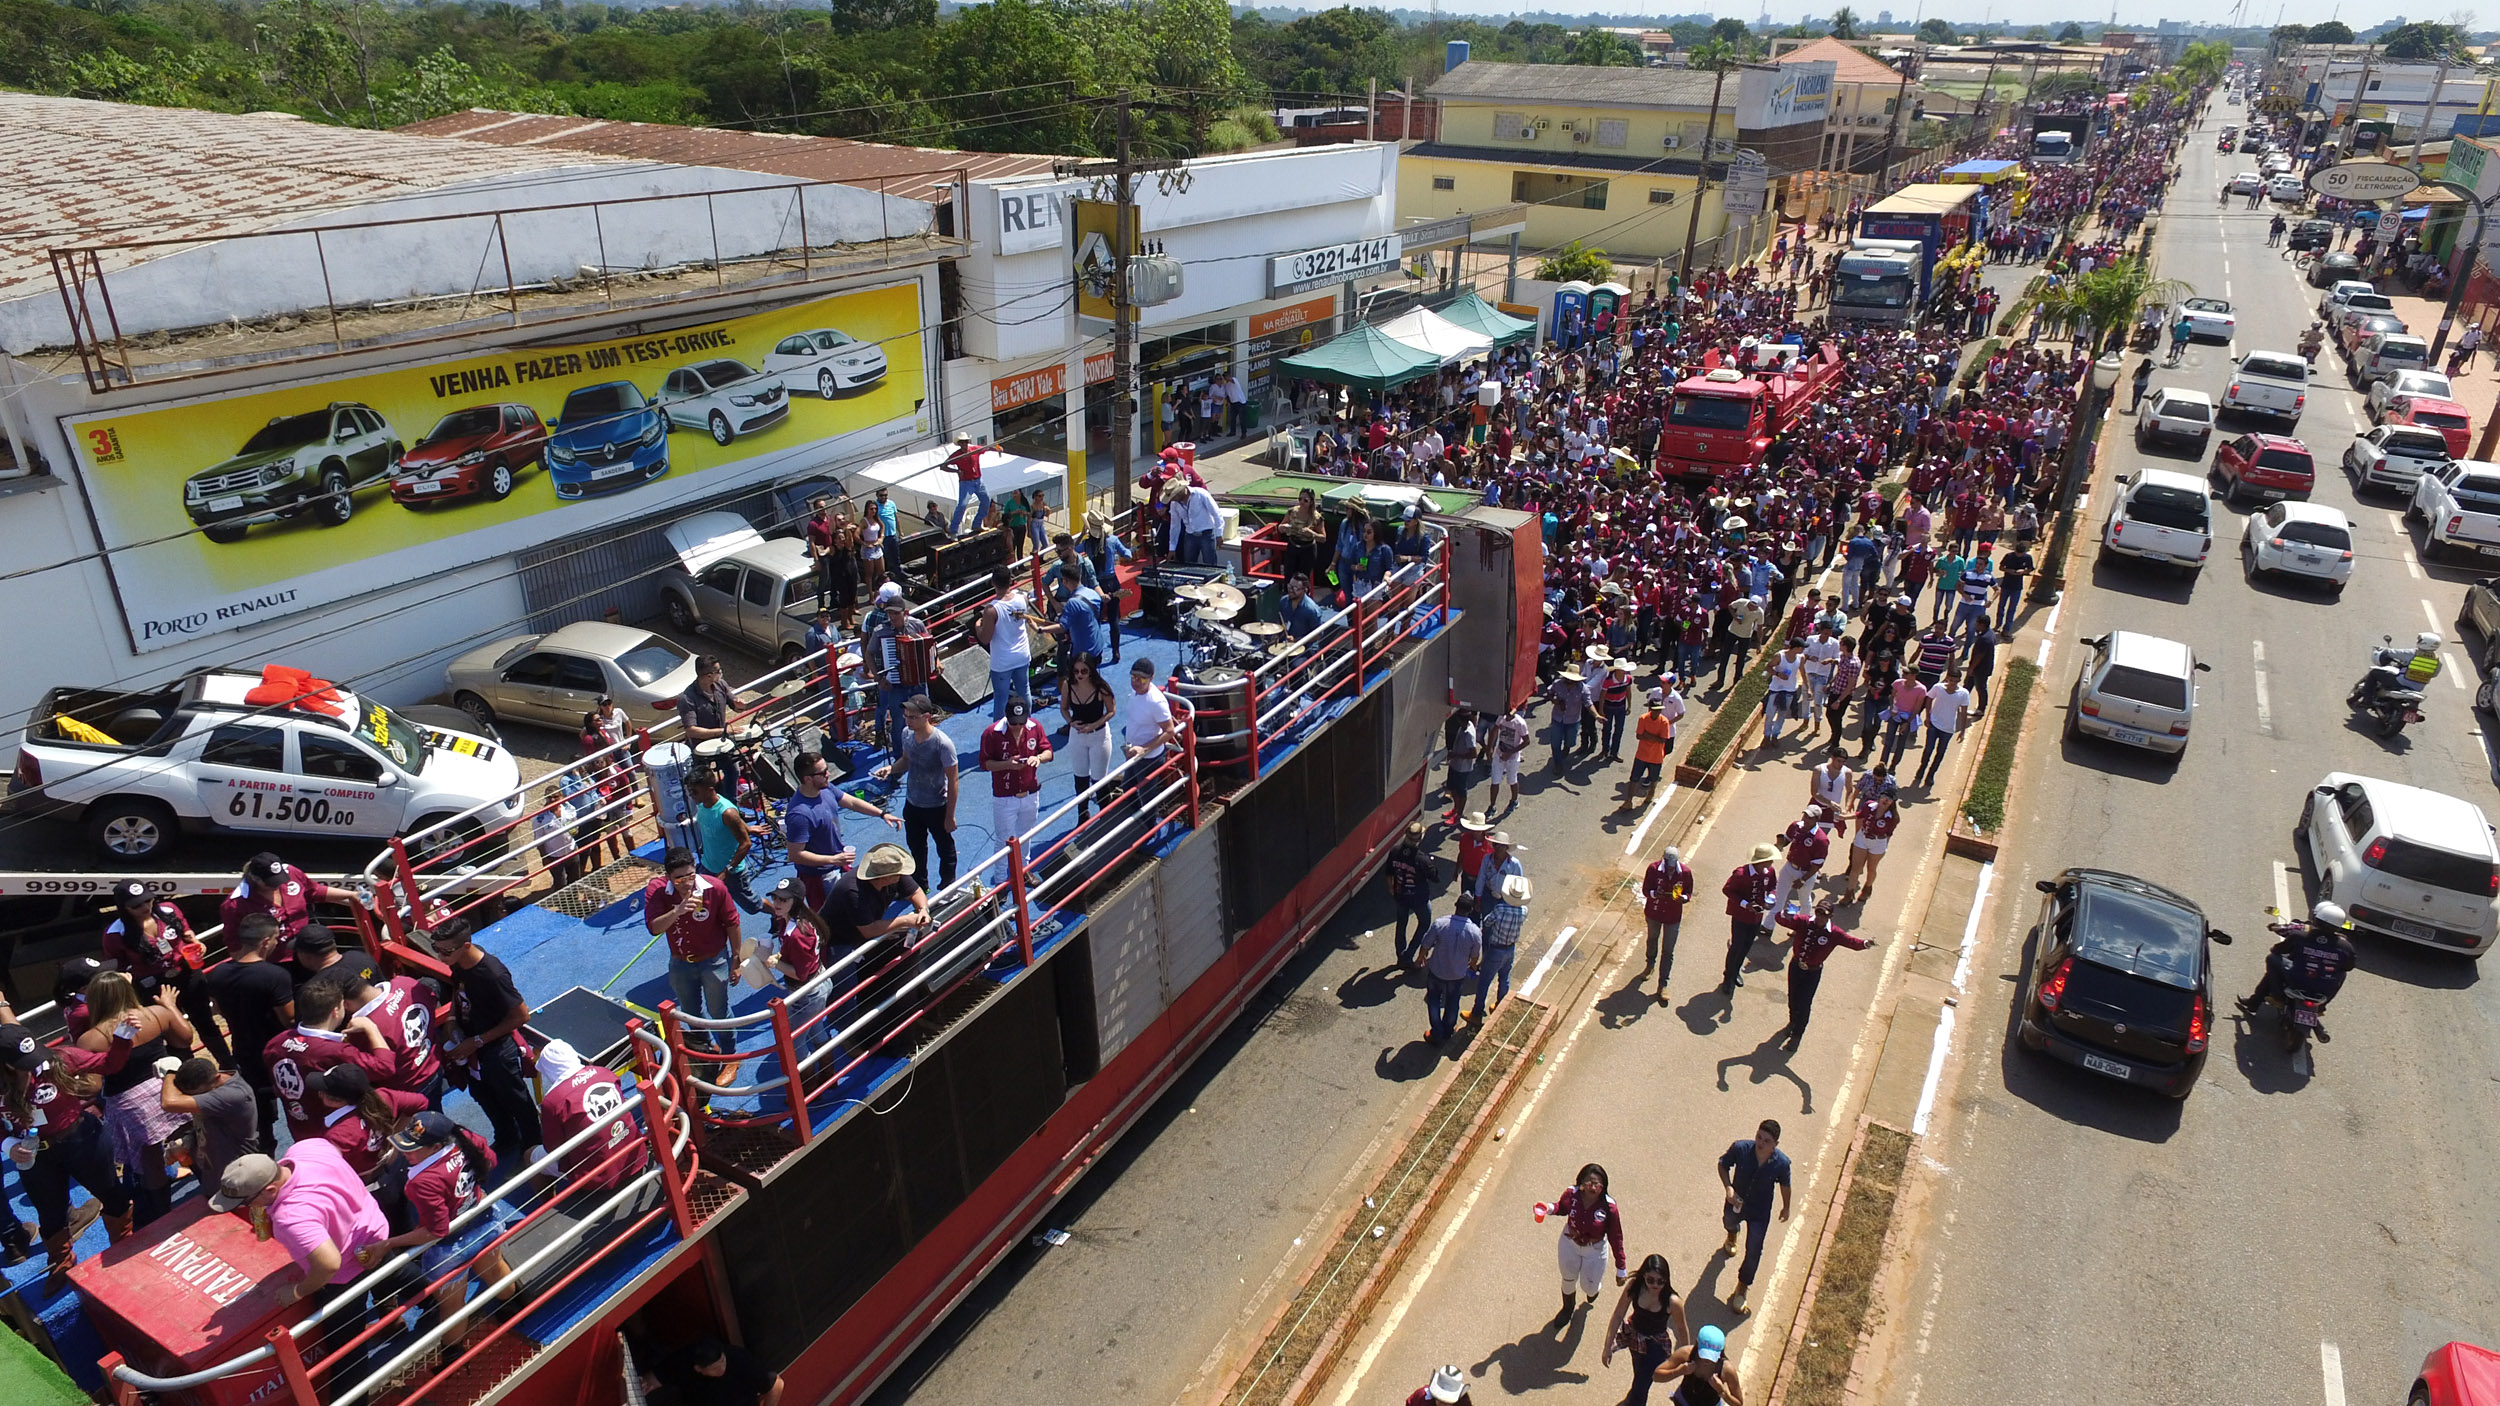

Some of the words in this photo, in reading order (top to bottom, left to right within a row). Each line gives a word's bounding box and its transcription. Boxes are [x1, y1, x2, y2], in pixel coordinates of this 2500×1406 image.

[2328, 174, 2348, 185] 50
[1001, 189, 1063, 233] REN
[2383, 217, 2396, 225] 50
[1305, 239, 1389, 277] 3221-4141
[1292, 264, 1389, 295] www.renaultriobranco.com.br
[1263, 321, 1275, 331] NA
[1274, 310, 1309, 328] RENAULT
[430, 365, 511, 398] VENHA
[515, 353, 582, 384] FAZER
[586, 346, 622, 371] UM
[1010, 375, 1035, 403] CNPJ
[1037, 372, 1053, 396] Vale
[1085, 354, 1114, 383] CONTÃO
[88, 429, 113, 456] 3
[96, 454, 116, 463] ANOS
[415, 482, 438, 492] CLIO
[216, 588, 298, 621] RENAULT
[1001, 741, 1010, 790] TEAS
[228, 779, 236, 787] A
[239, 779, 277, 792] PARTIR
[279, 783, 293, 793] DE
[323, 788, 376, 801] COMPLETO
[228, 791, 355, 826] 61.500,00
[25, 880, 177, 893] 9999-760
[1569, 1199, 1578, 1228] TEX
